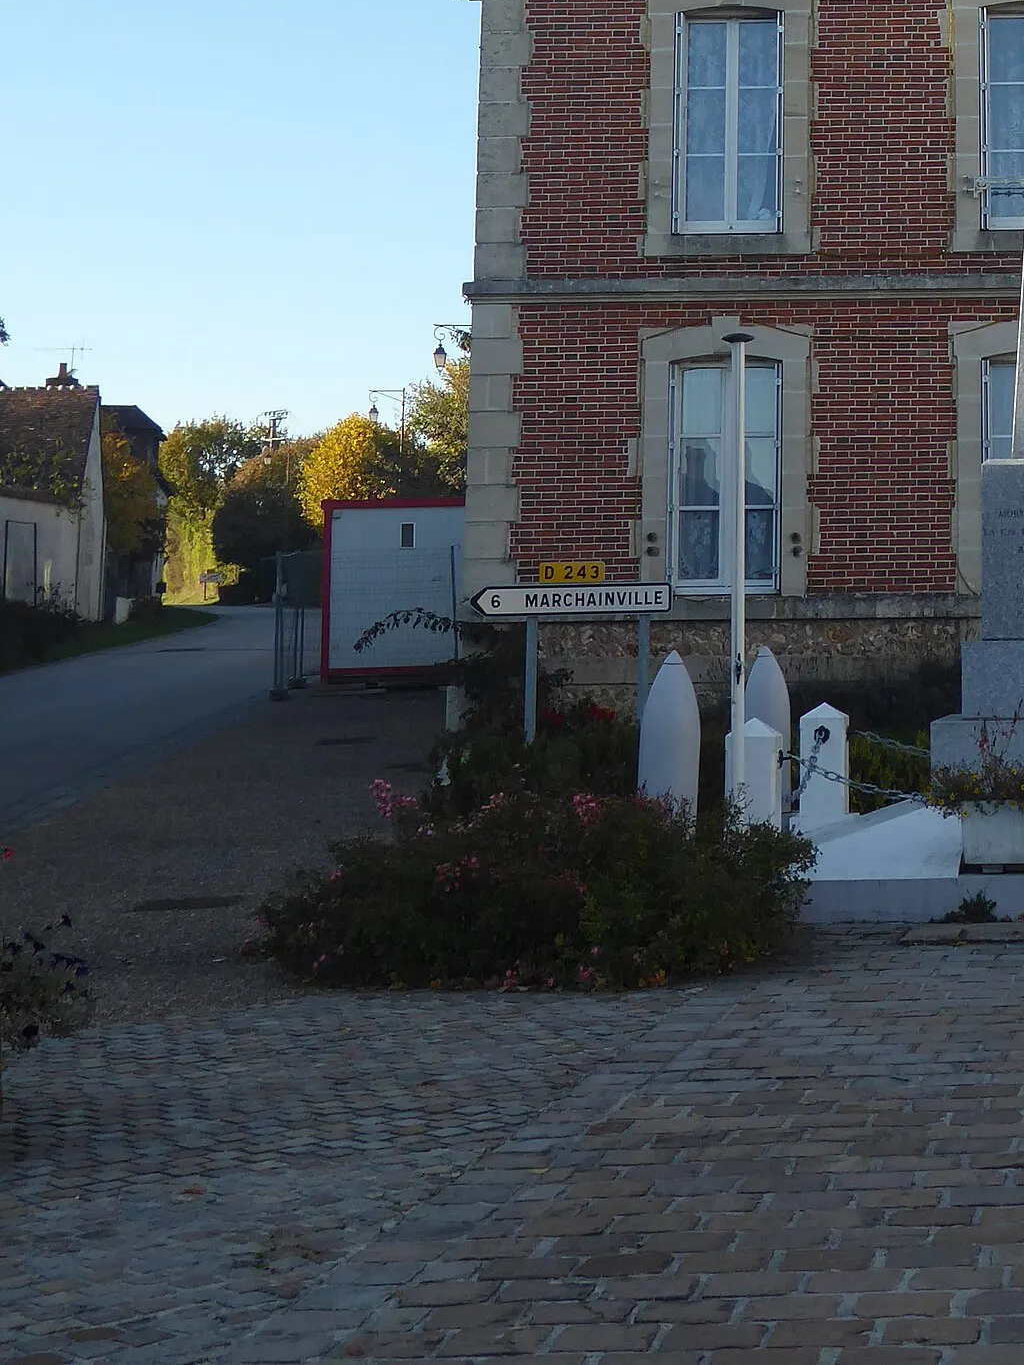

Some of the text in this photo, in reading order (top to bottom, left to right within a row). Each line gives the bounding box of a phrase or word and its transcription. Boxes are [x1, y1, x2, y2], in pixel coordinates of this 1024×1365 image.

[543, 564, 600, 581] D 243
[490, 590, 663, 609] 6 MARCHAINVILLE
